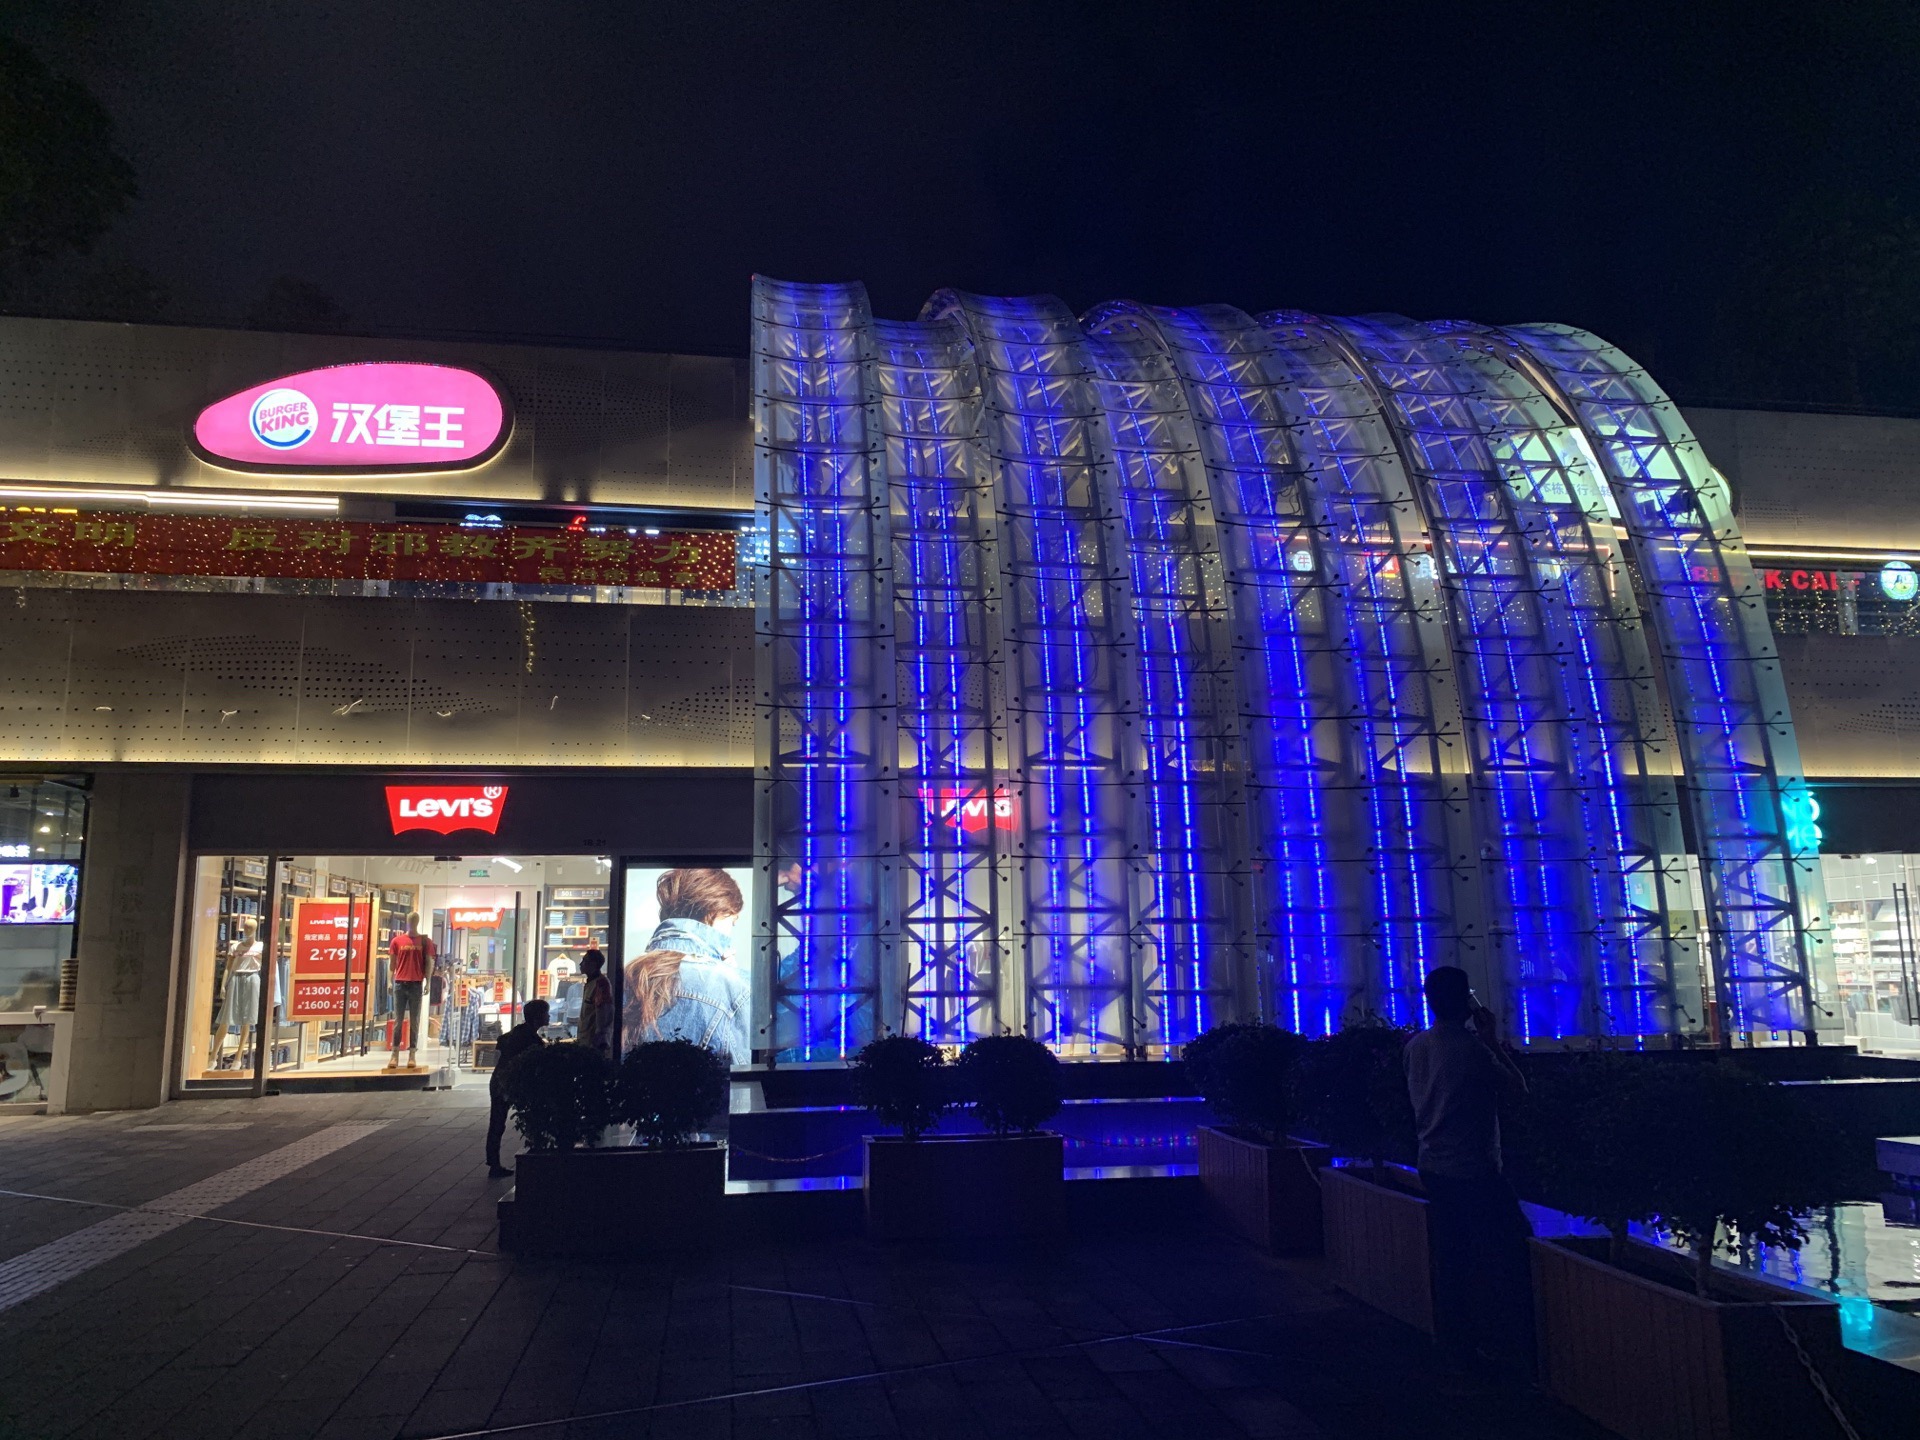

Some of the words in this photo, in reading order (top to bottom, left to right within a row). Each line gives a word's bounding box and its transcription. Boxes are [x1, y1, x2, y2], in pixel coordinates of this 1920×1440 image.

[259, 402, 307, 420] BURGER
[261, 411, 309, 434] KING
[330, 402, 465, 448] 汉堡王
[0, 519, 135, 547] 文明
[399, 798, 493, 818] Levi's
